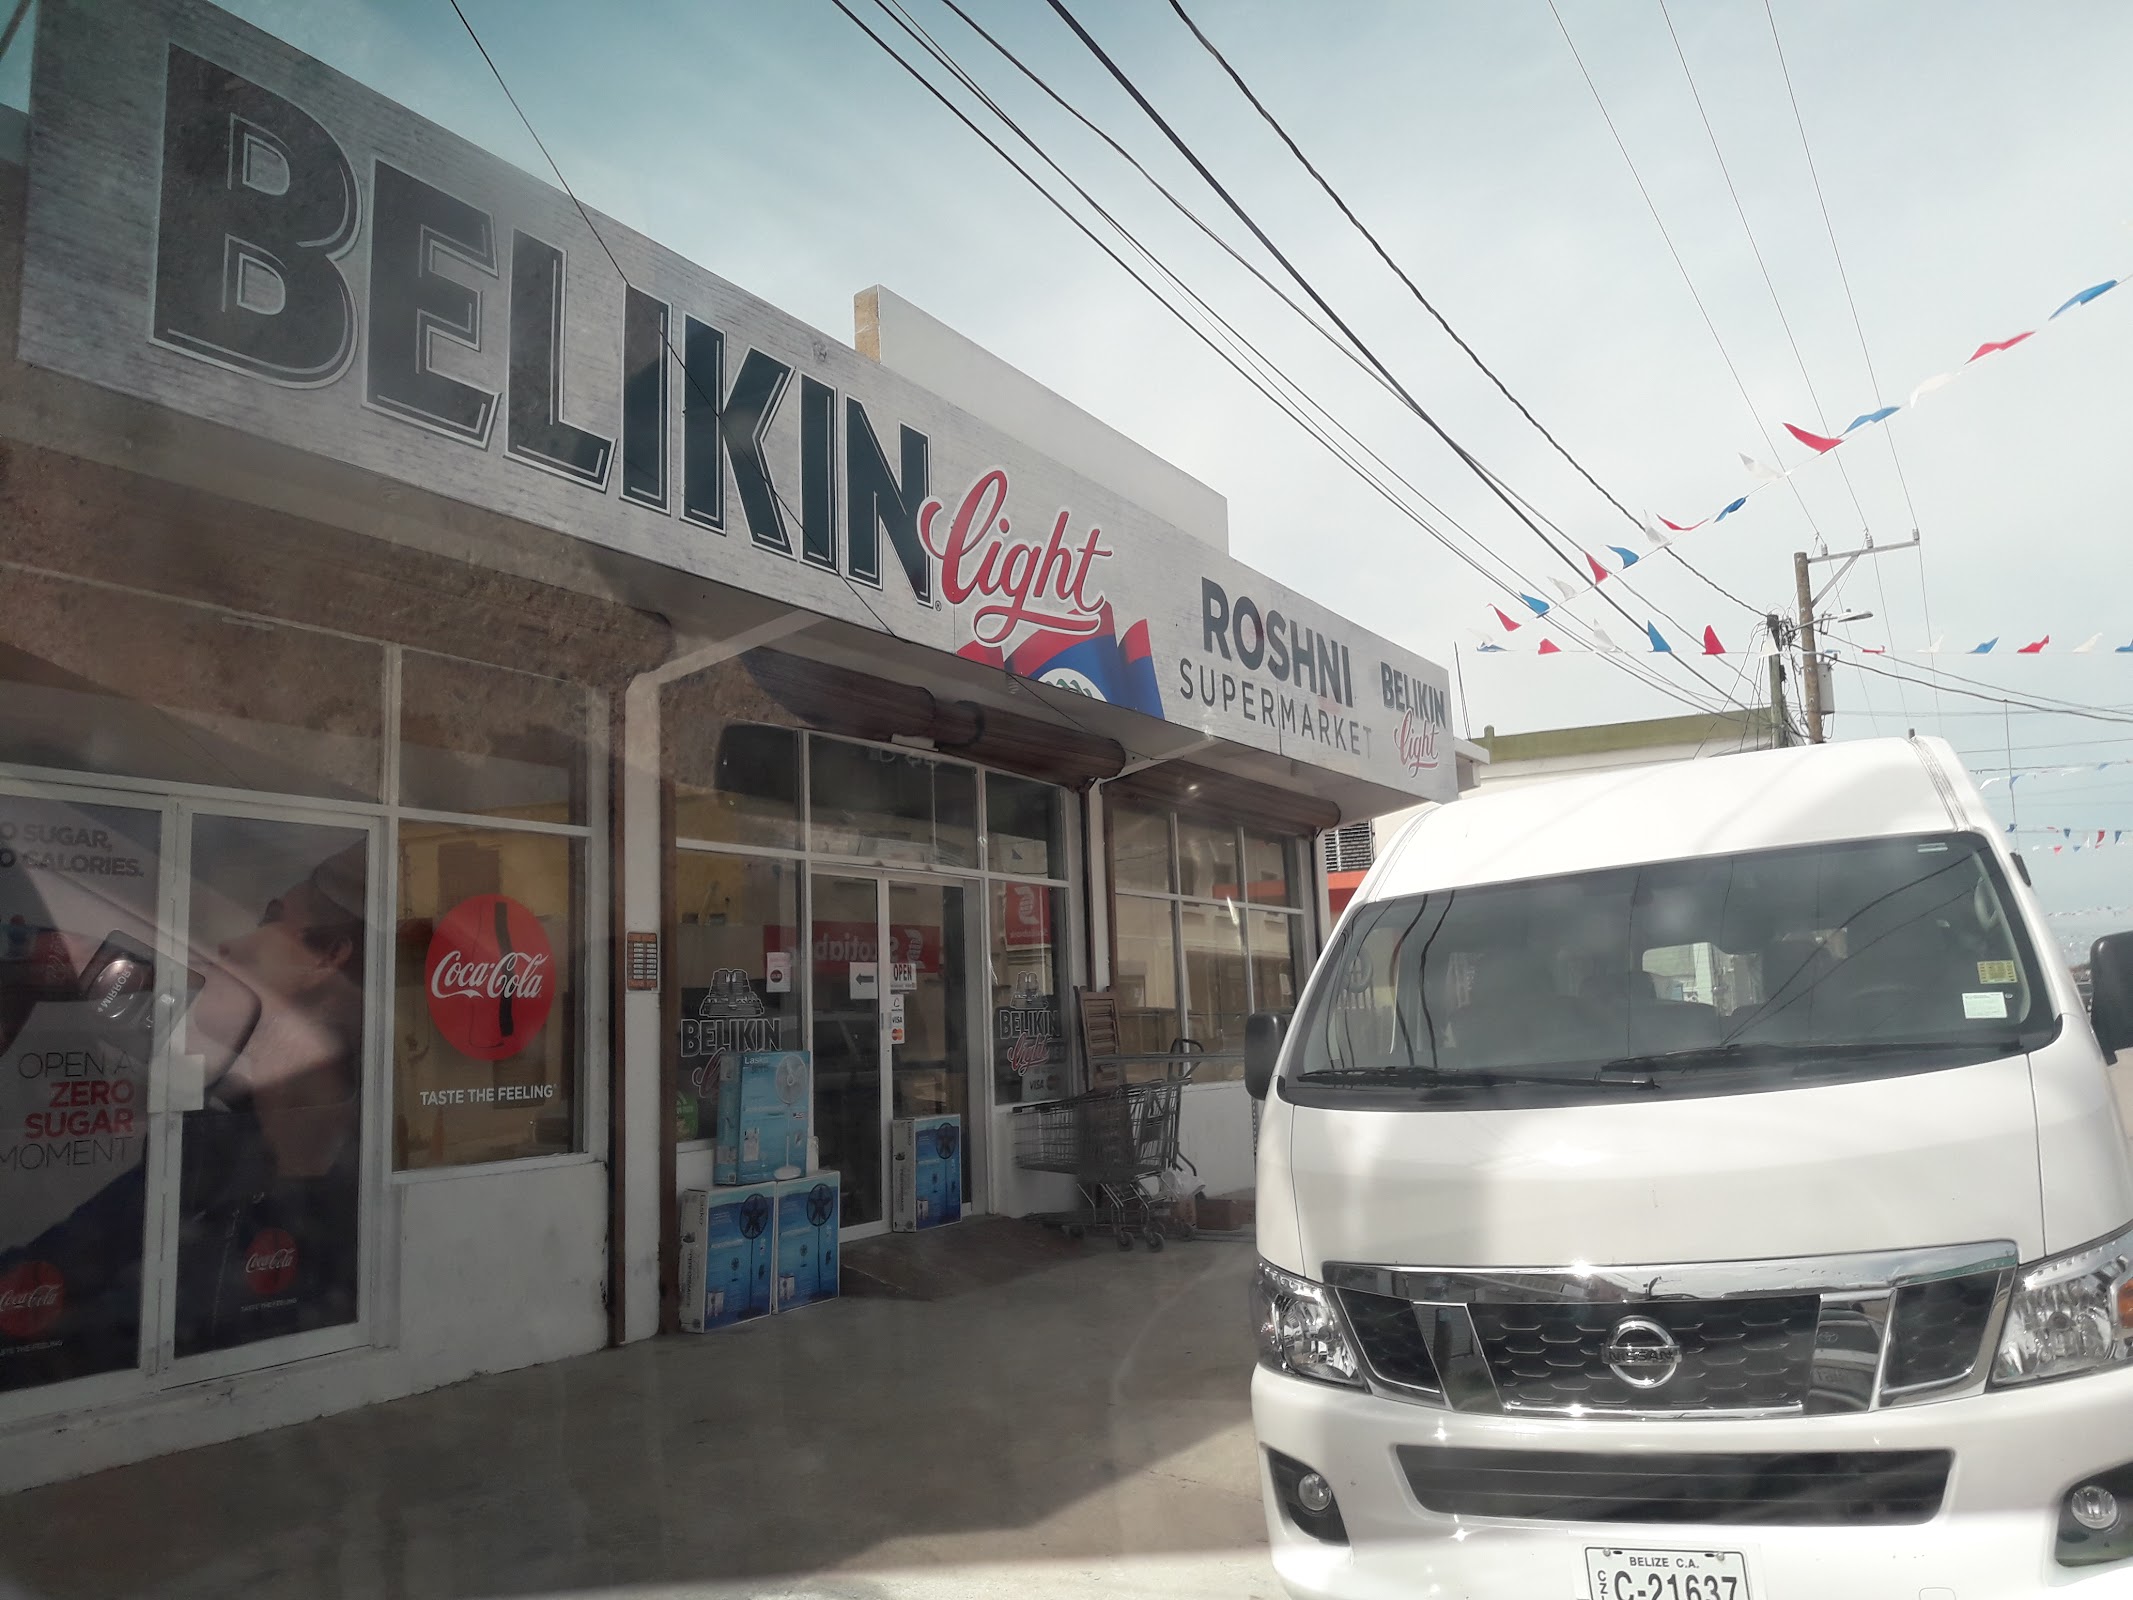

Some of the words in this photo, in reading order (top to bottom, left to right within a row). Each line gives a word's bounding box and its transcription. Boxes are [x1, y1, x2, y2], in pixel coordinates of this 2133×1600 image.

[147, 42, 933, 610] BELIKIN
[1201, 576, 1354, 708] ROSHNI
[1180, 657, 1372, 760] SUPERMARKET
[1380, 660, 1447, 730] BELIKIN
[430, 950, 549, 999] Coca-Cola
[893, 963, 912, 982] OPEN
[681, 1018, 783, 1058] BELIKIN
[1000, 1010, 1060, 1039] BELIKIN
[18, 1051, 105, 1079] OPEN
[113, 1050, 134, 1075] A
[50, 1079, 135, 1108] ZERO
[419, 1090, 465, 1106] TASTE
[468, 1088, 495, 1103] THE
[497, 1084, 554, 1102] FEELING
[24, 1108, 134, 1139] SUGAR
[1608, 1350, 1673, 1362] NISSAN
[1629, 1556, 1670, 1568] BELIZE
[1675, 1558, 1700, 1569] C.A.
[1614, 1570, 1738, 1600] C-21637
